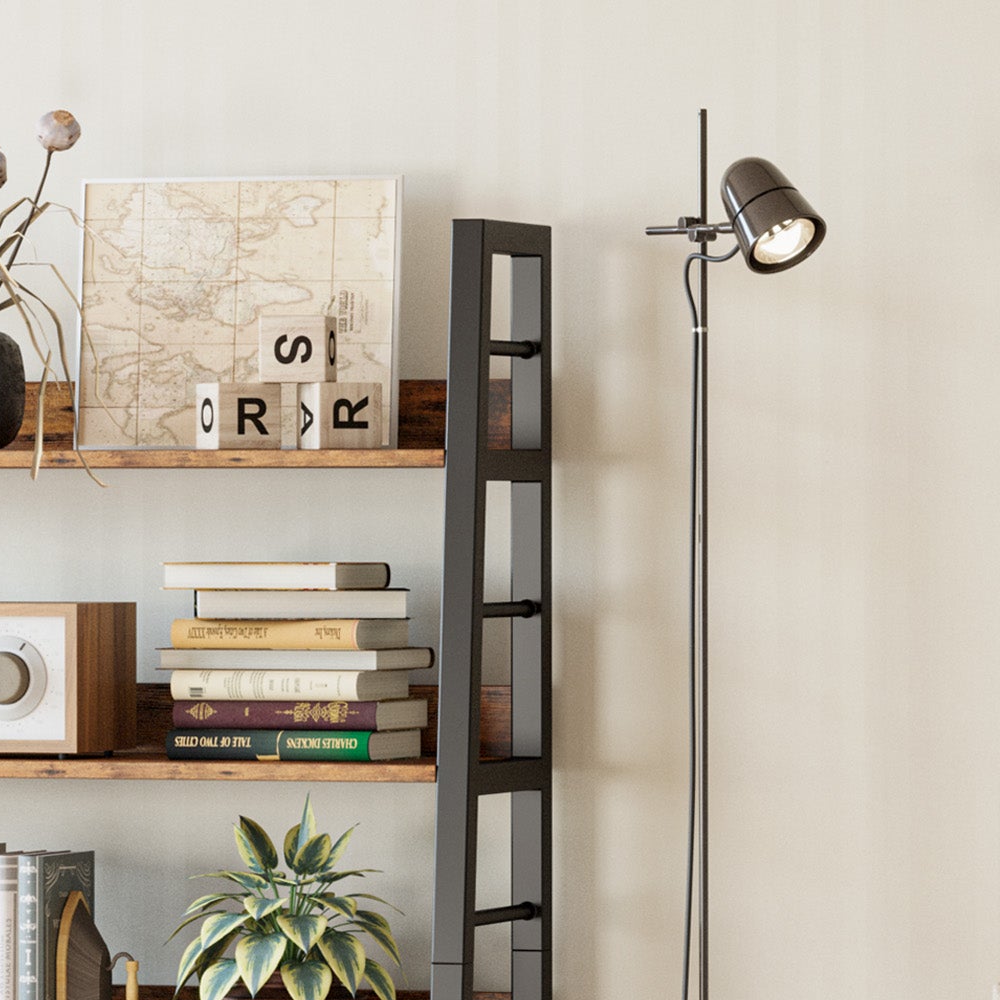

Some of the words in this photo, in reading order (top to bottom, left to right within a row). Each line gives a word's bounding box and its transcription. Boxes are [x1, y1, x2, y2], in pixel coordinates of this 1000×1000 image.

[273, 333, 313, 365] S
[236, 397, 270, 436] R
[332, 395, 370, 430] R
[174, 736, 199, 748] CITIES
[199, 736, 219, 748] TWO
[219, 736, 231, 748] OF
[232, 736, 252, 749] TALE
[286, 737, 321, 749] DICKENS
[321, 737, 358, 749] CHARLES
